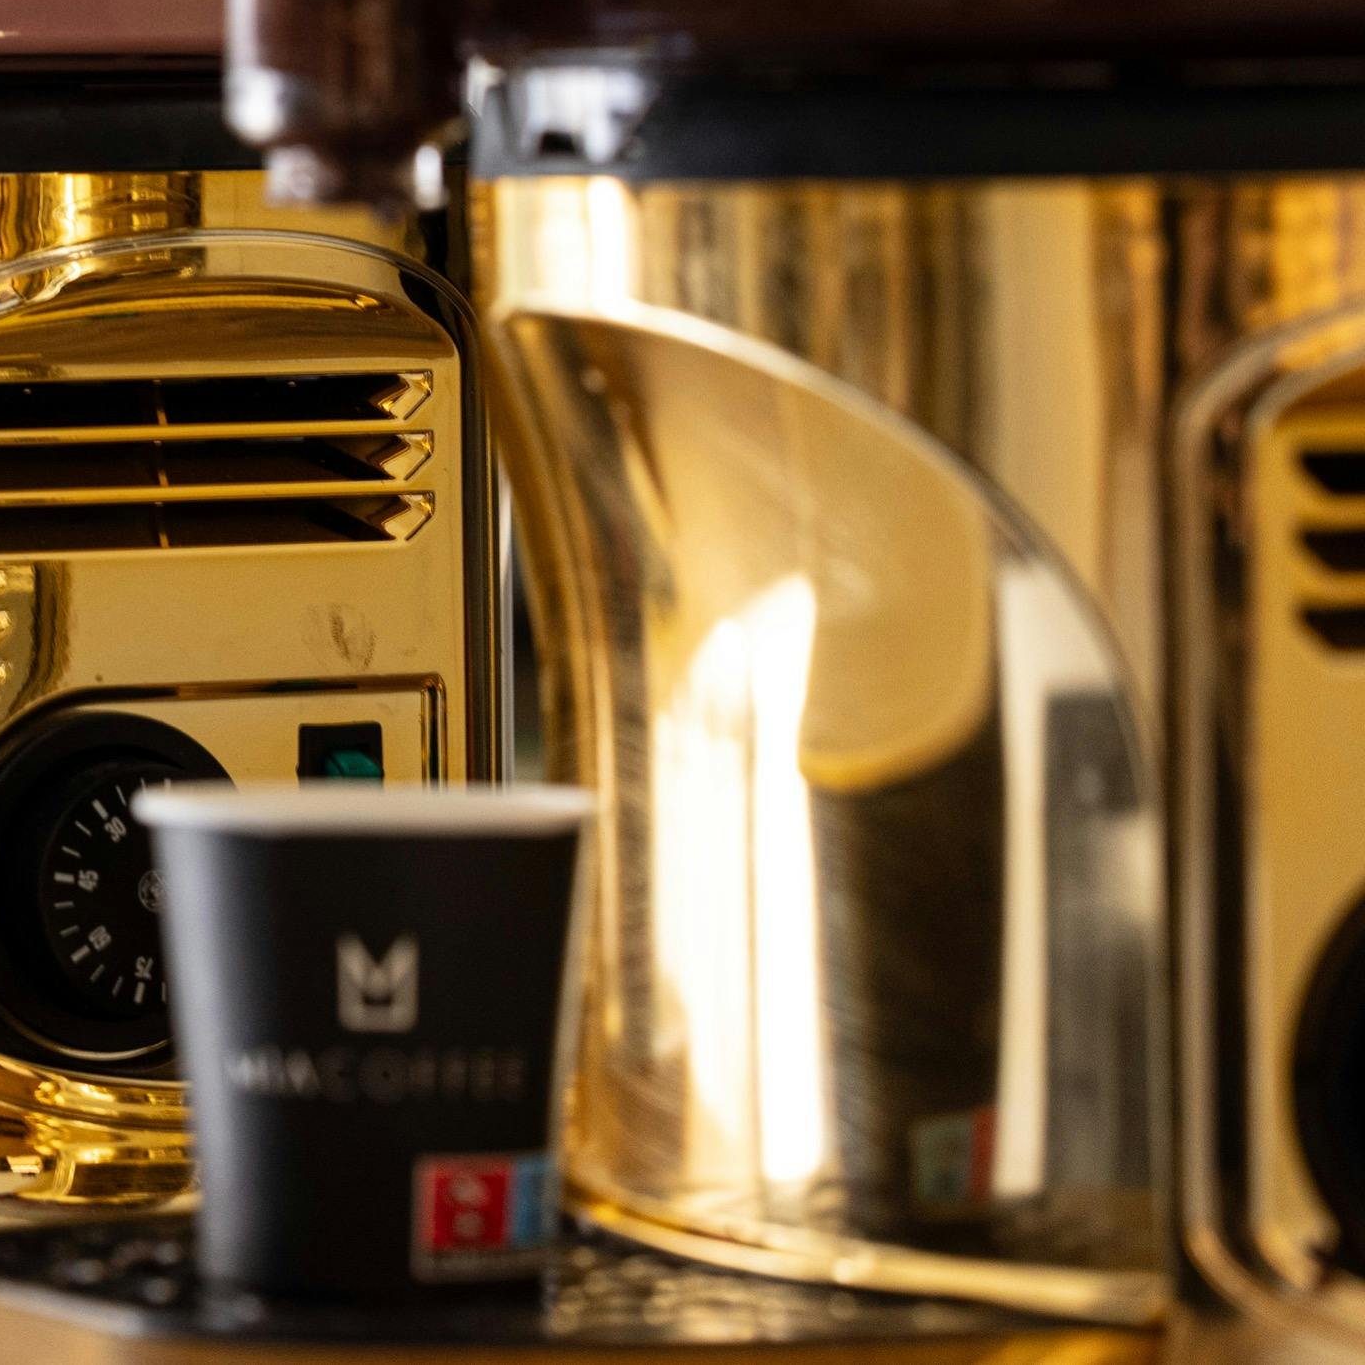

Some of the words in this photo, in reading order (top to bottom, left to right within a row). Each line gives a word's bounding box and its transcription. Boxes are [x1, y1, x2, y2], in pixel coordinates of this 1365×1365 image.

[104, 815, 127, 843] 30
[77, 869, 99, 892] 45
[133, 955, 154, 981] 75
